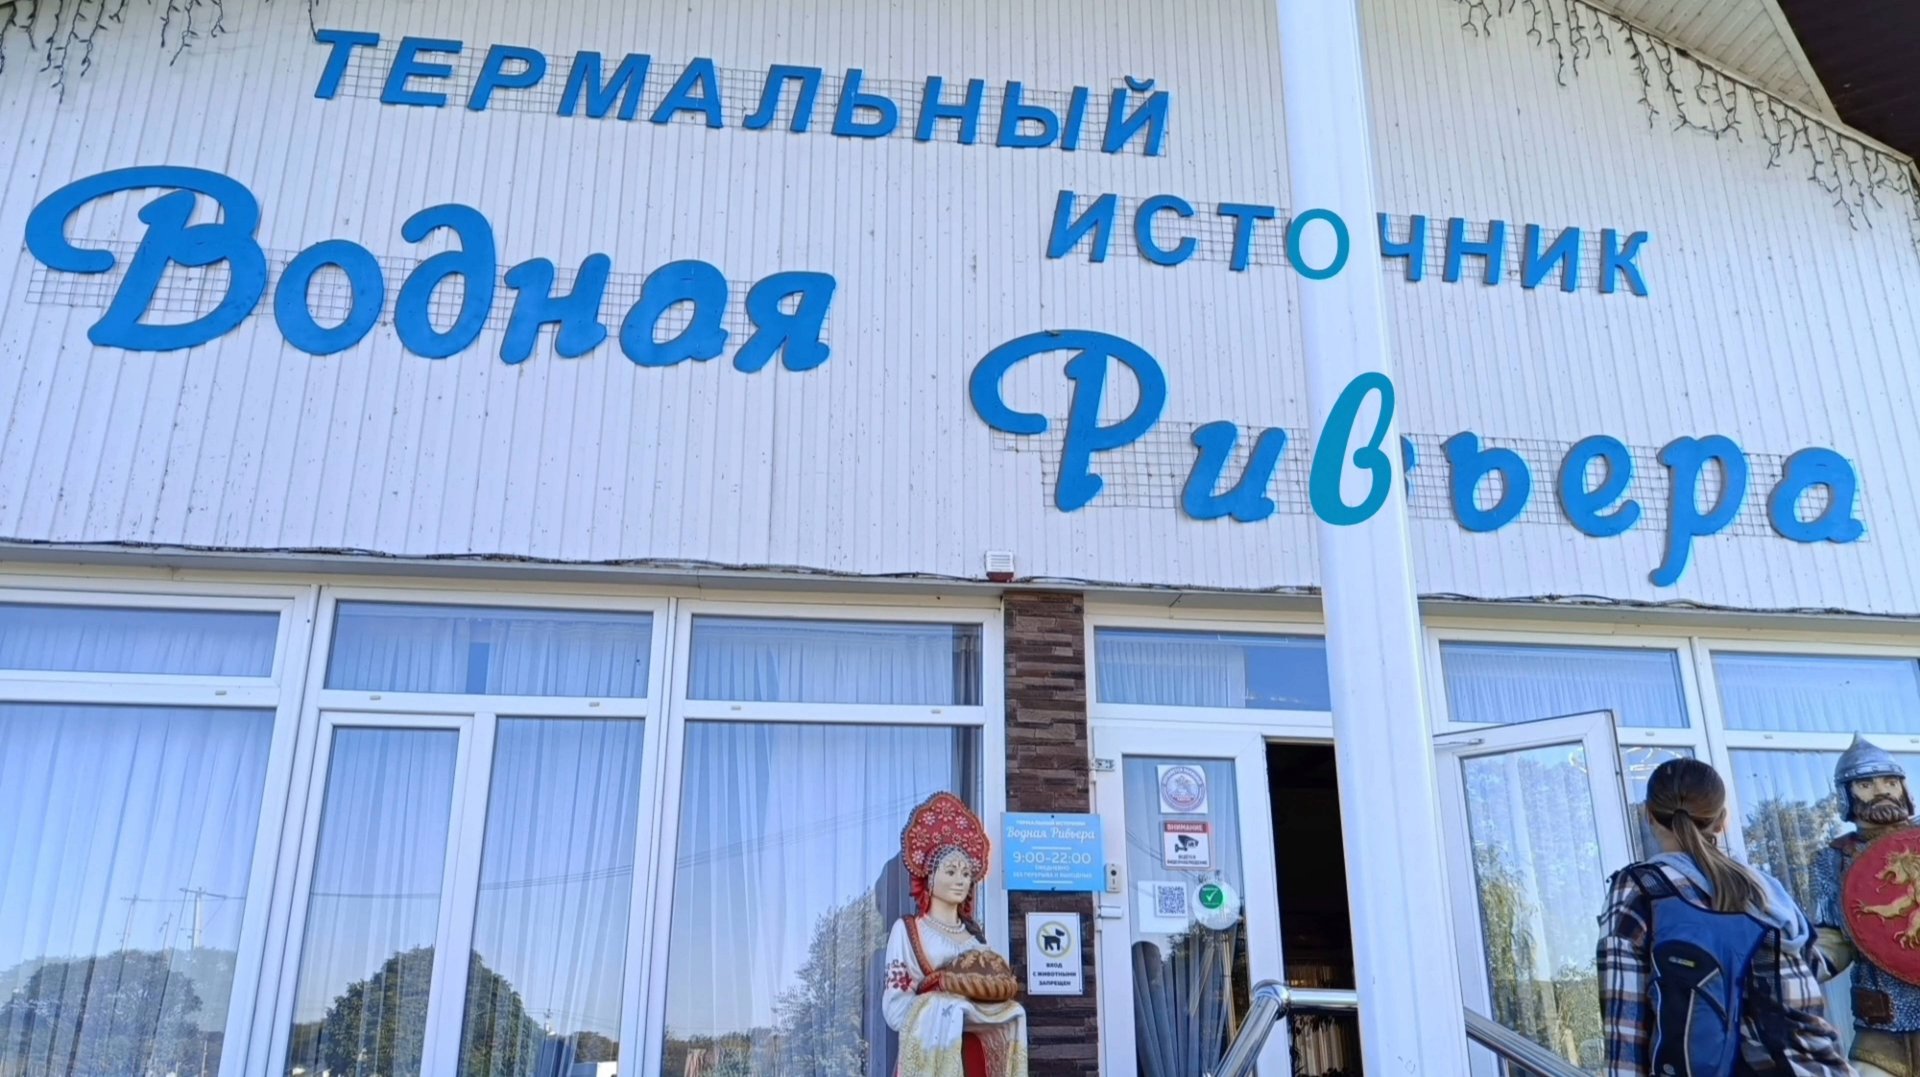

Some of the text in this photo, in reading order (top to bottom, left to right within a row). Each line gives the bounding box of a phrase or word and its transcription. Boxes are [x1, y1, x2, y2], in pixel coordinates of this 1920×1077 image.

[315, 29, 1170, 158] ТЕРМАЛЬНЫЙ
[25, 165, 836, 375] Водная
[1047, 190, 1650, 298] ИСТОЧНИК
[971, 330, 1866, 588] Ривьера
[1007, 826, 1095, 844] Водная Ривьера
[1013, 851, 1092, 865] 9:00-22:00
[1167, 823, 1203, 831] ВНИМАНИЕ
